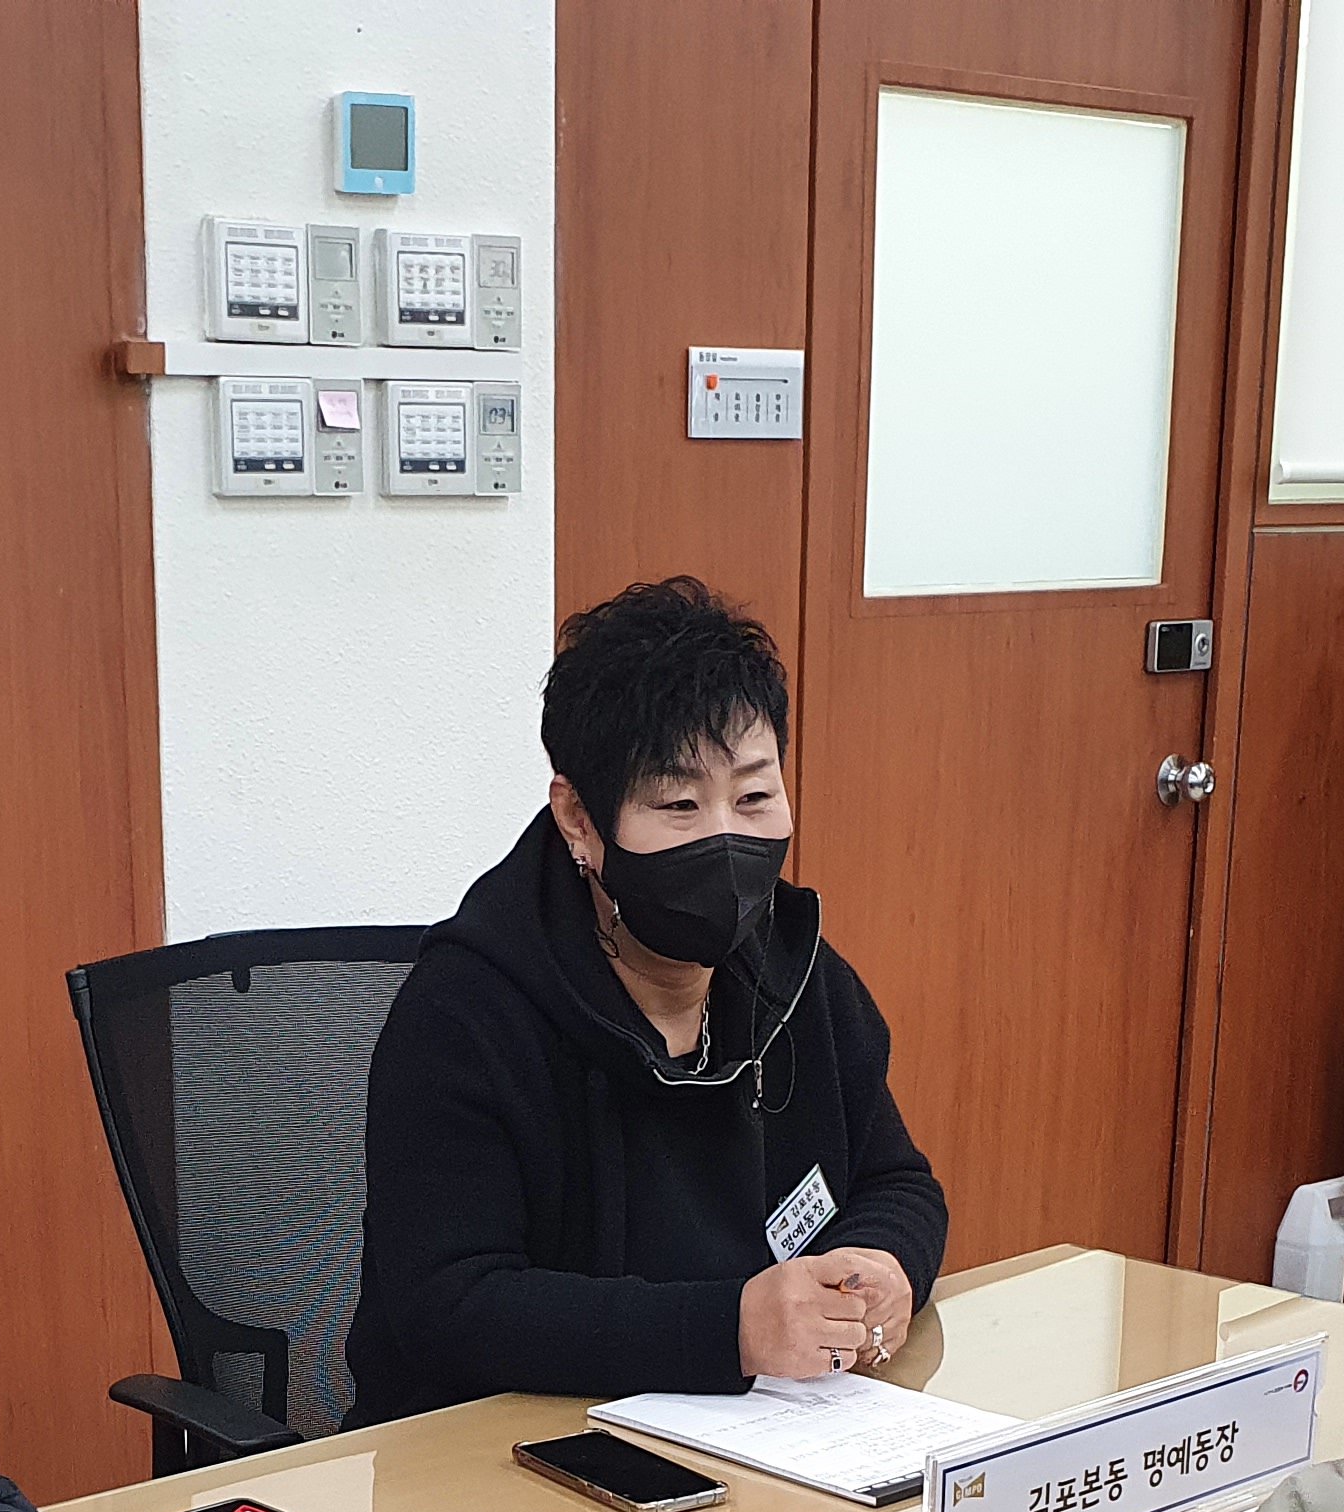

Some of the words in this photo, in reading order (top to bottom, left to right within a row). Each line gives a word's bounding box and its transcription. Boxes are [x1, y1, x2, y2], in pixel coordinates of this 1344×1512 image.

[780, 1198, 825, 1252] 명예동장
[790, 1180, 821, 1219] 김포본동
[1142, 1420, 1240, 1488] 명예동장
